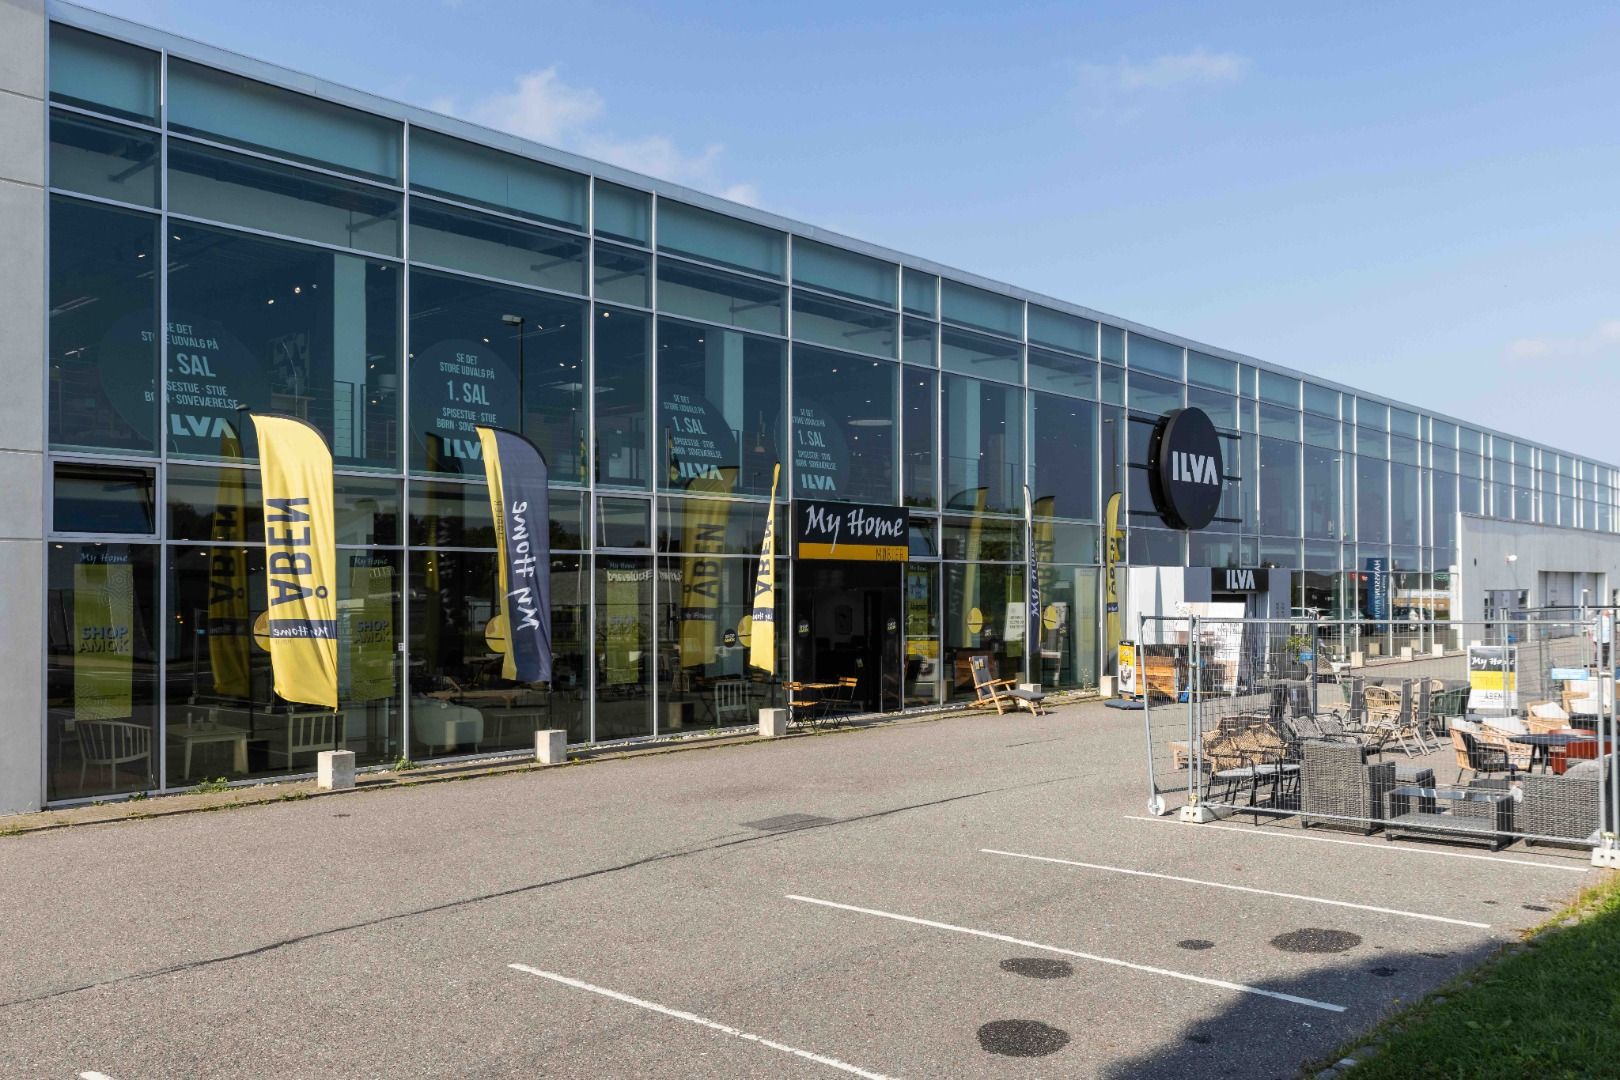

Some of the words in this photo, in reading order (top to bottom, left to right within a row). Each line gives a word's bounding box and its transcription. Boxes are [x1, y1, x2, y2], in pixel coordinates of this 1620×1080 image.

[176, 323, 193, 335] DET
[171, 335, 206, 349] UDVALG
[207, 338, 219, 350] PÅ
[176, 352, 217, 378] SAL
[456, 353, 465, 363] SE
[466, 355, 478, 365] DET
[440, 361, 460, 374] STORE
[461, 365, 485, 378] UDVALG
[205, 384, 228, 396] STUE
[462, 382, 490, 406] SAL
[442, 406, 477, 421] SPISESTUE
[481, 412, 497, 423] STUE
[683, 416, 708, 435] SAL
[807, 430, 826, 448] SAL
[443, 438, 484, 460] ILV
[678, 461, 724, 481] ILVA
[1172, 450, 1219, 486] ILVA
[801, 473, 837, 491] ILVA
[804, 504, 841, 555] My
[847, 507, 904, 539] Home
[80, 552, 97, 567] My
[101, 552, 128, 563] Home
[1226, 569, 1256, 590] ILVA
[81, 624, 128, 641] SHOP
[357, 619, 389, 633] SHOP
[1471, 656, 1487, 670] My
